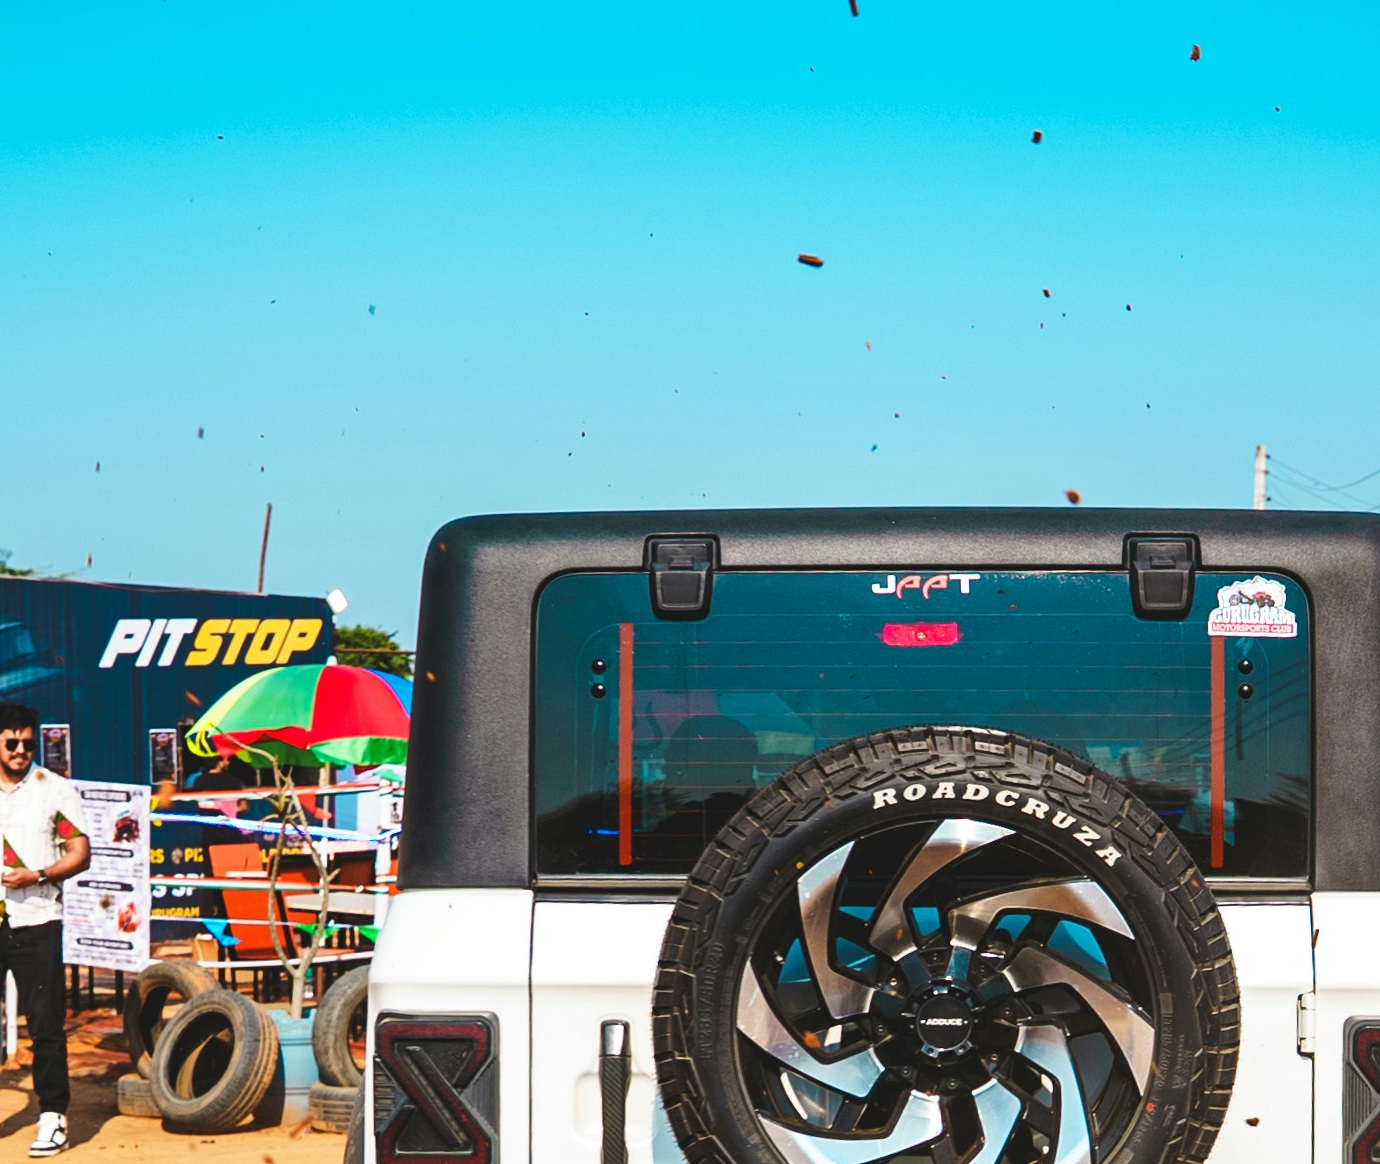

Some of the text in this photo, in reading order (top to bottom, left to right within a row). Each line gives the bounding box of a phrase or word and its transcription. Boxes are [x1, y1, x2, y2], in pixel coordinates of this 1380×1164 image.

[1212, 622, 1293, 633] MOTORSPORTS CLUB
[1214, 603, 1296, 625] GURUGRAM
[98, 618, 323, 668] PIT STOP
[872, 782, 1122, 867] ROADCRUZA
